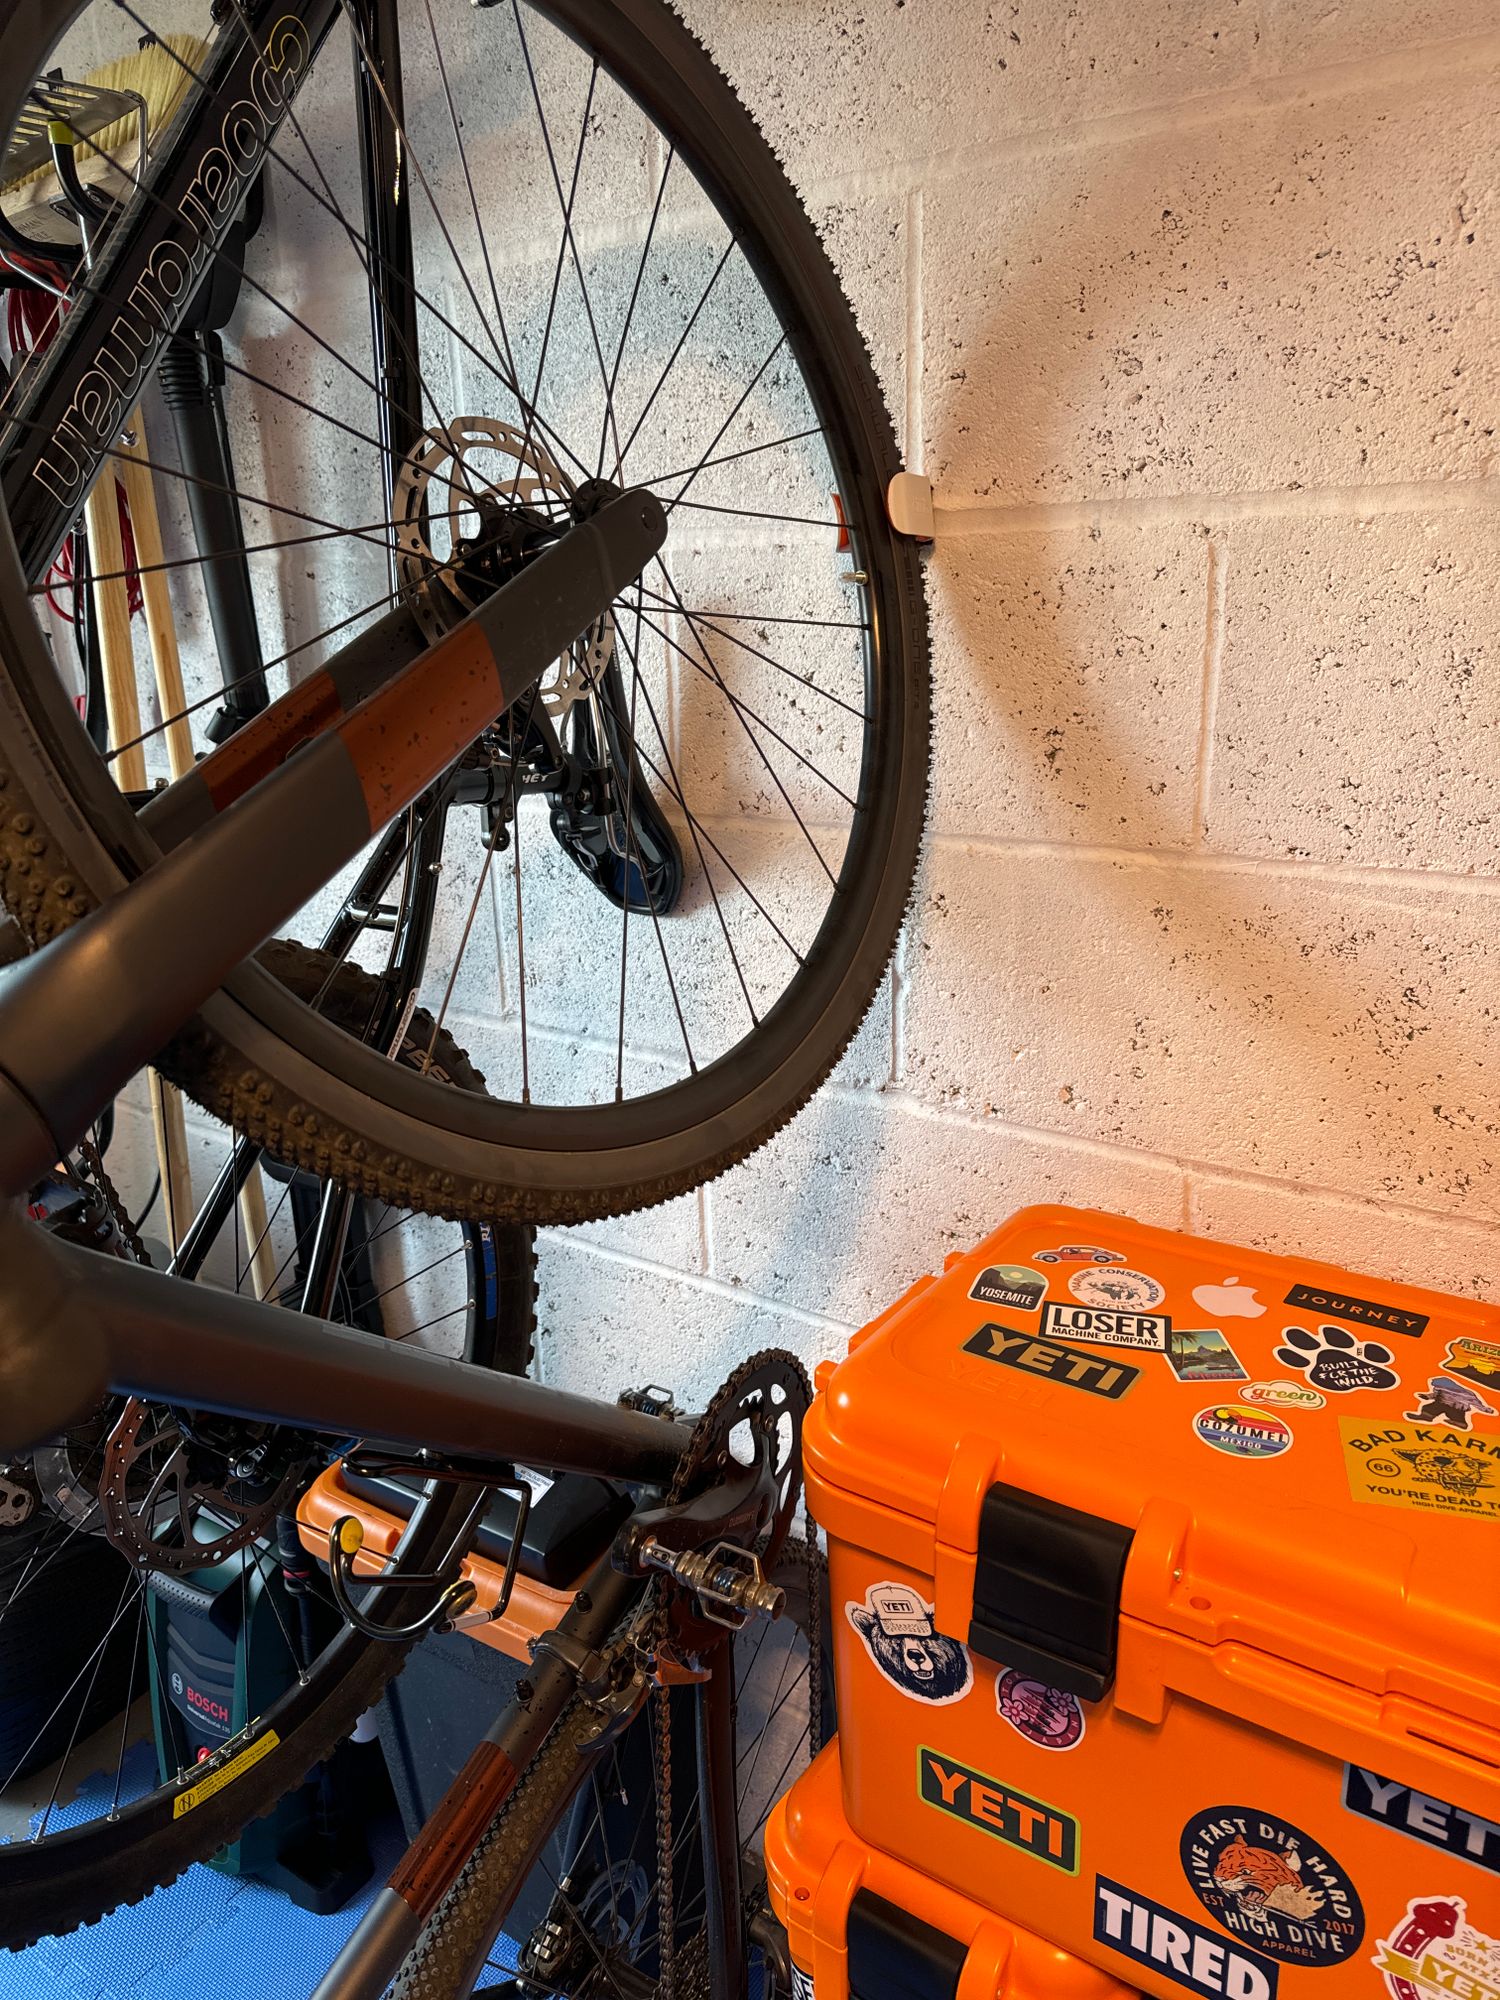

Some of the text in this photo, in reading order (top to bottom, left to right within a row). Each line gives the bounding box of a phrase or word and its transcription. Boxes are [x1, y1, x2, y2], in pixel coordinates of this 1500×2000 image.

[852, 365, 893, 472] SCHWAL
[979, 1286, 1035, 1306] YOSEMITE
[1072, 1268, 1159, 1303] MARINE CONSERVATION
[1088, 1298, 1146, 1311] SOCIETY
[1297, 1292, 1419, 1328] JOURNEY
[1051, 1326, 1101, 1340] MACHINE
[1053, 1308, 1159, 1339] LOSER
[987, 1329, 1125, 1391] YETI
[1319, 1360, 1360, 1371] BUILT
[1319, 1367, 1378, 1380] FOR THE
[1252, 1386, 1317, 1400] green
[1199, 1418, 1288, 1444] COZUMEL
[1348, 1430, 1406, 1452] BAD
[1373, 1463, 1394, 1473] 66
[1366, 1484, 1431, 1501] YOU'RE
[1435, 1493, 1483, 1508] DEAD
[1411, 1500, 1435, 1509] HIGH
[1436, 1503, 1458, 1512] DIVE
[883, 1602, 911, 1612] YETI
[186, 1686, 229, 1722] BOSCH
[1026, 1720, 1080, 1745] JAPAN
[928, 1758, 1063, 1858] YETI
[1192, 1818, 1352, 1919] LIVE FAST DIE HARD
[1202, 1892, 1356, 1936] EST 2017
[1099, 1886, 1271, 2000] TIRED
[1224, 1910, 1345, 1954] HIGH DIVE
[1262, 1939, 1317, 1959] APPAREL
[1460, 1960, 1490, 1980] ATX
